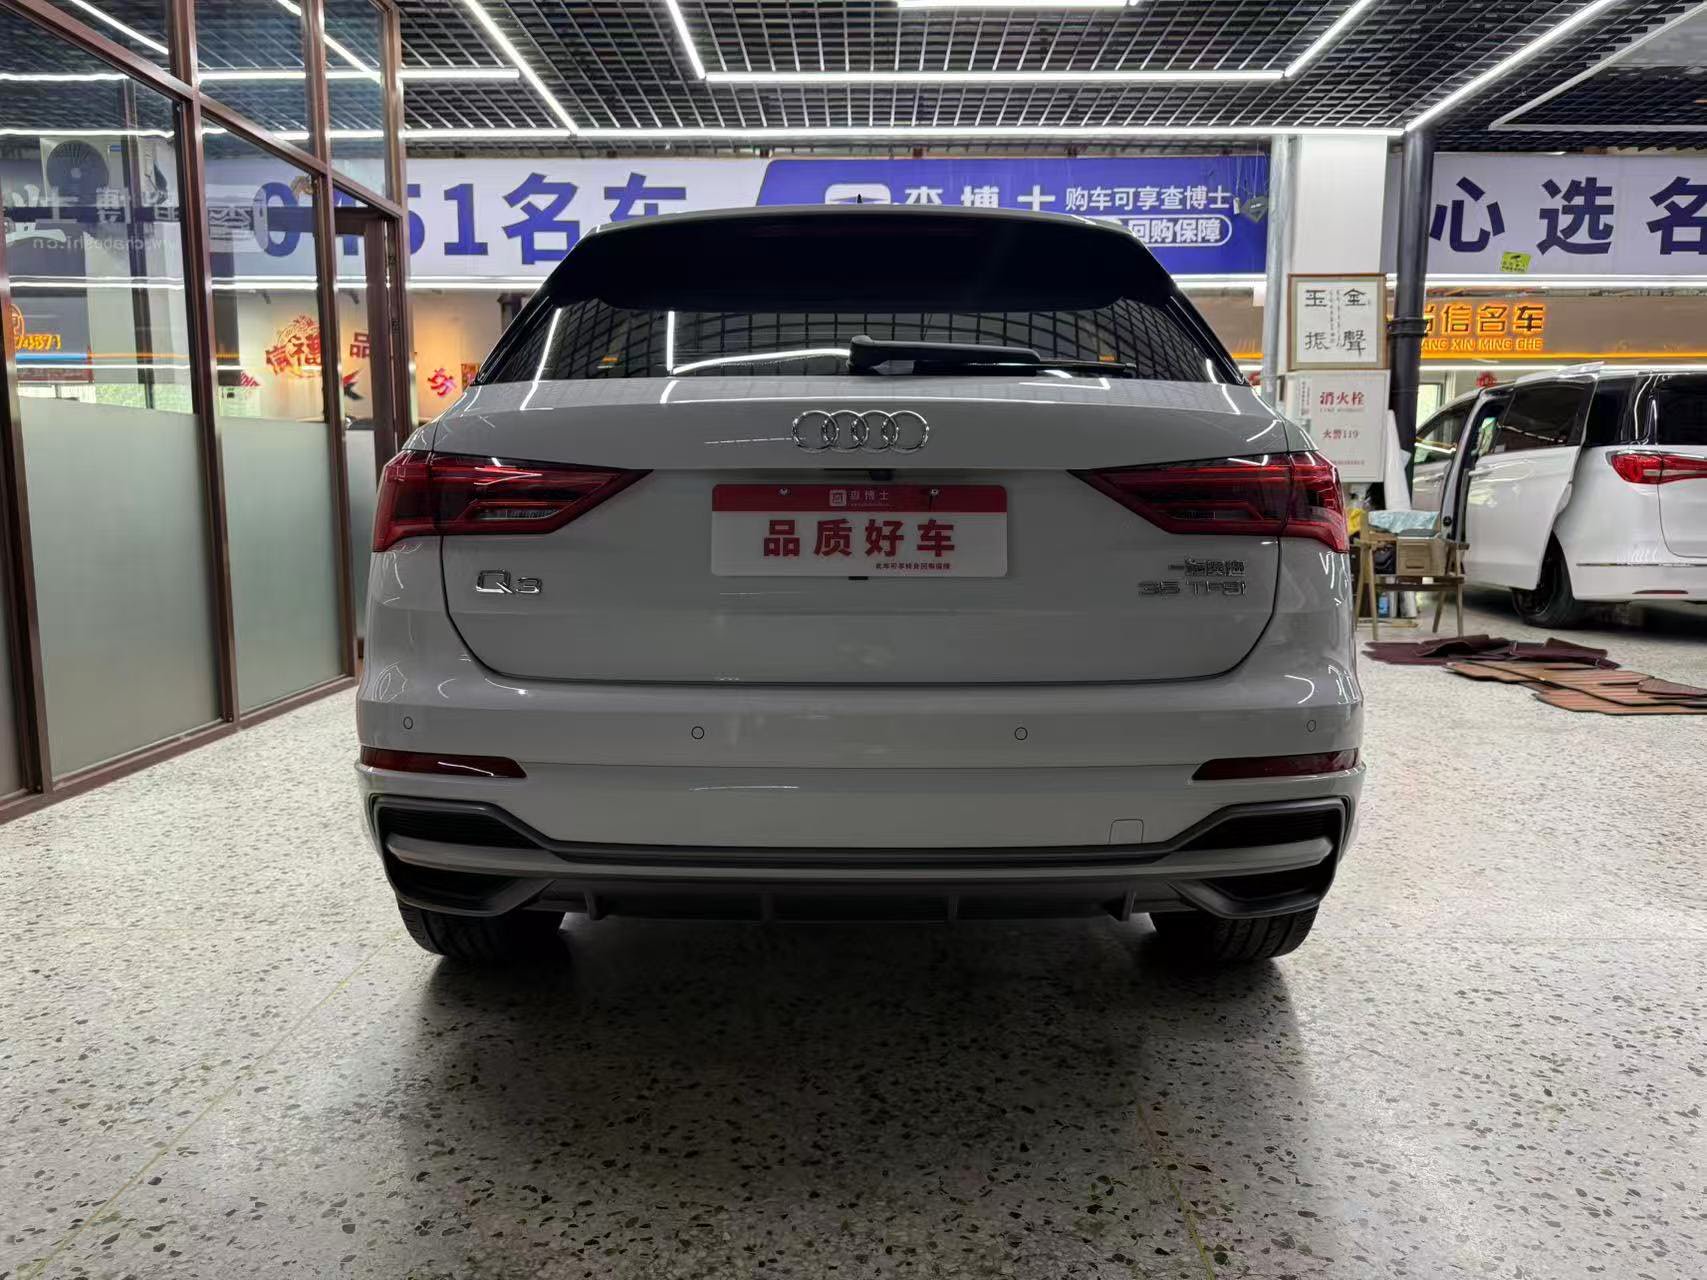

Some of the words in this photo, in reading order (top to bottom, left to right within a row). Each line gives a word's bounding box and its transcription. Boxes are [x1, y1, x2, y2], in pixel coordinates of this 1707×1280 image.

[1065, 187, 1231, 211] 购车可享查博士
[1128, 218, 1221, 242] 回购保障
[1479, 339, 1511, 351] MING
[1515, 339, 1543, 351] CHE
[1319, 391, 1365, 406] 消火栓
[763, 518, 955, 558] 品质好车
[476, 569, 542, 594] Q3
